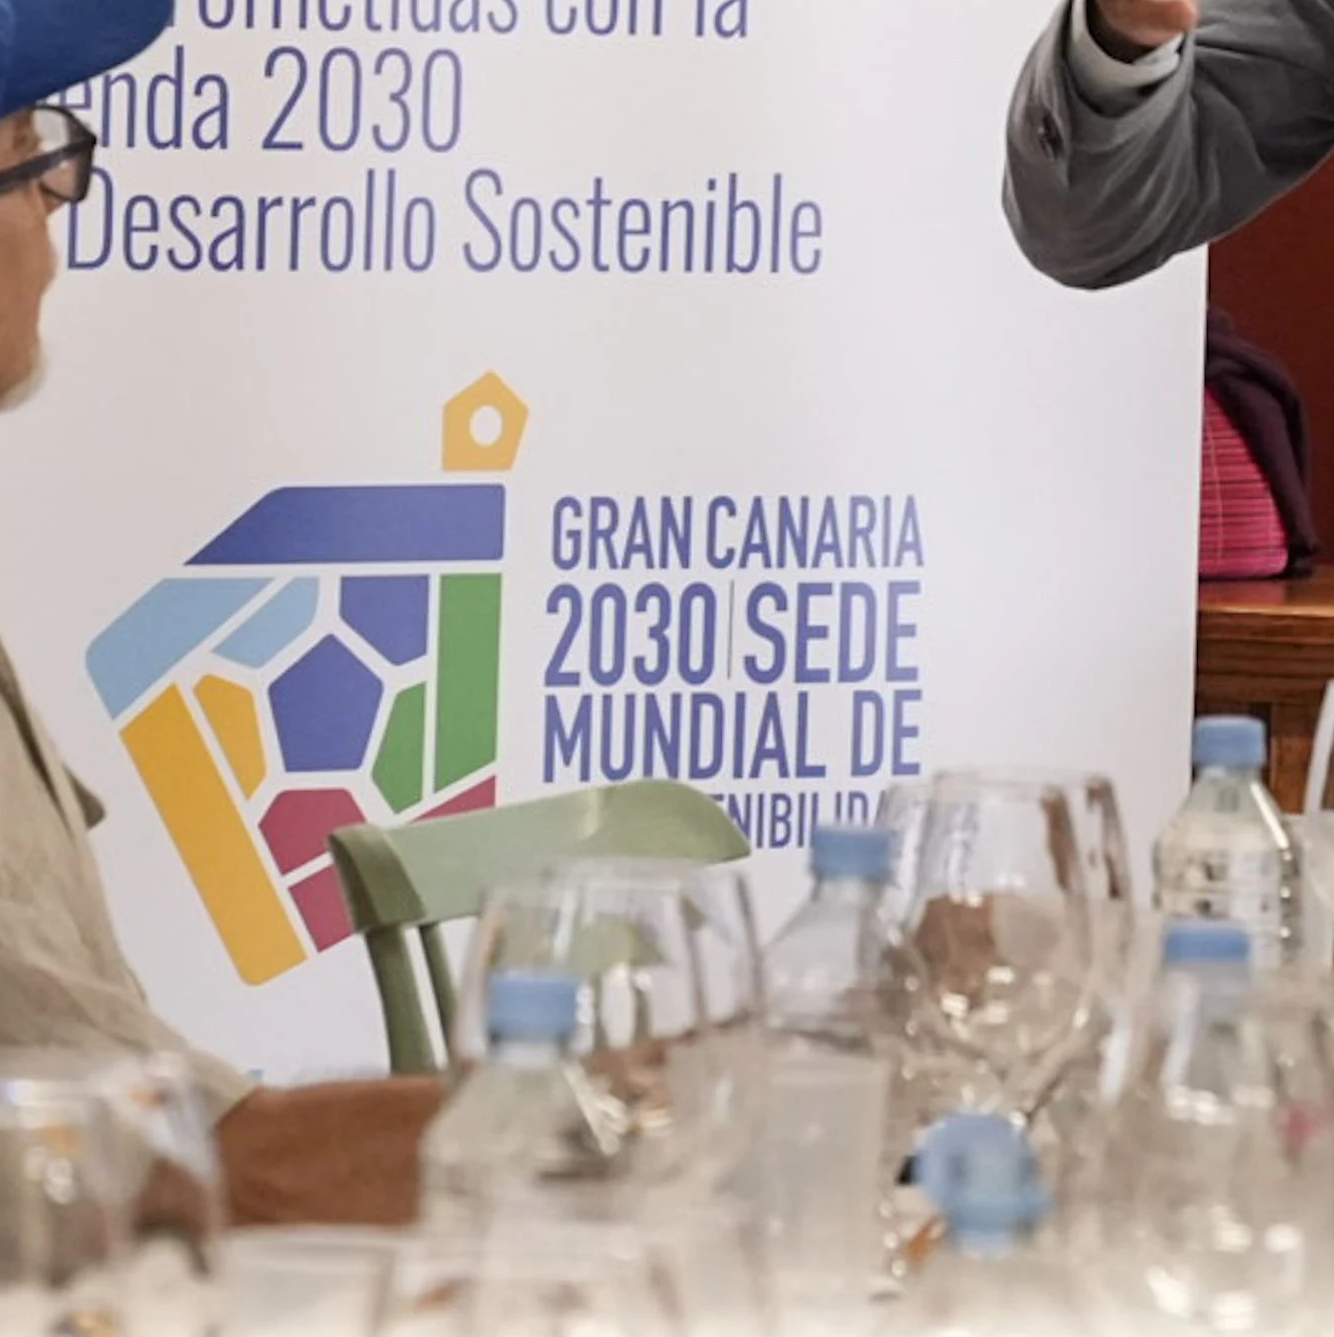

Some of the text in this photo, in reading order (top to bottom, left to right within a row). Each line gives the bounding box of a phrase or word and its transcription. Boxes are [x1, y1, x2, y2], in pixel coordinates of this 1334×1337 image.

[260, 44, 463, 154] 2030
[66, 166, 824, 275] Desarrollo Sostenible
[551, 494, 925, 571] GRAN CANARIA
[543, 580, 922, 688] 2030 SEDE
[542, 689, 923, 784] MUNDIAL DE
